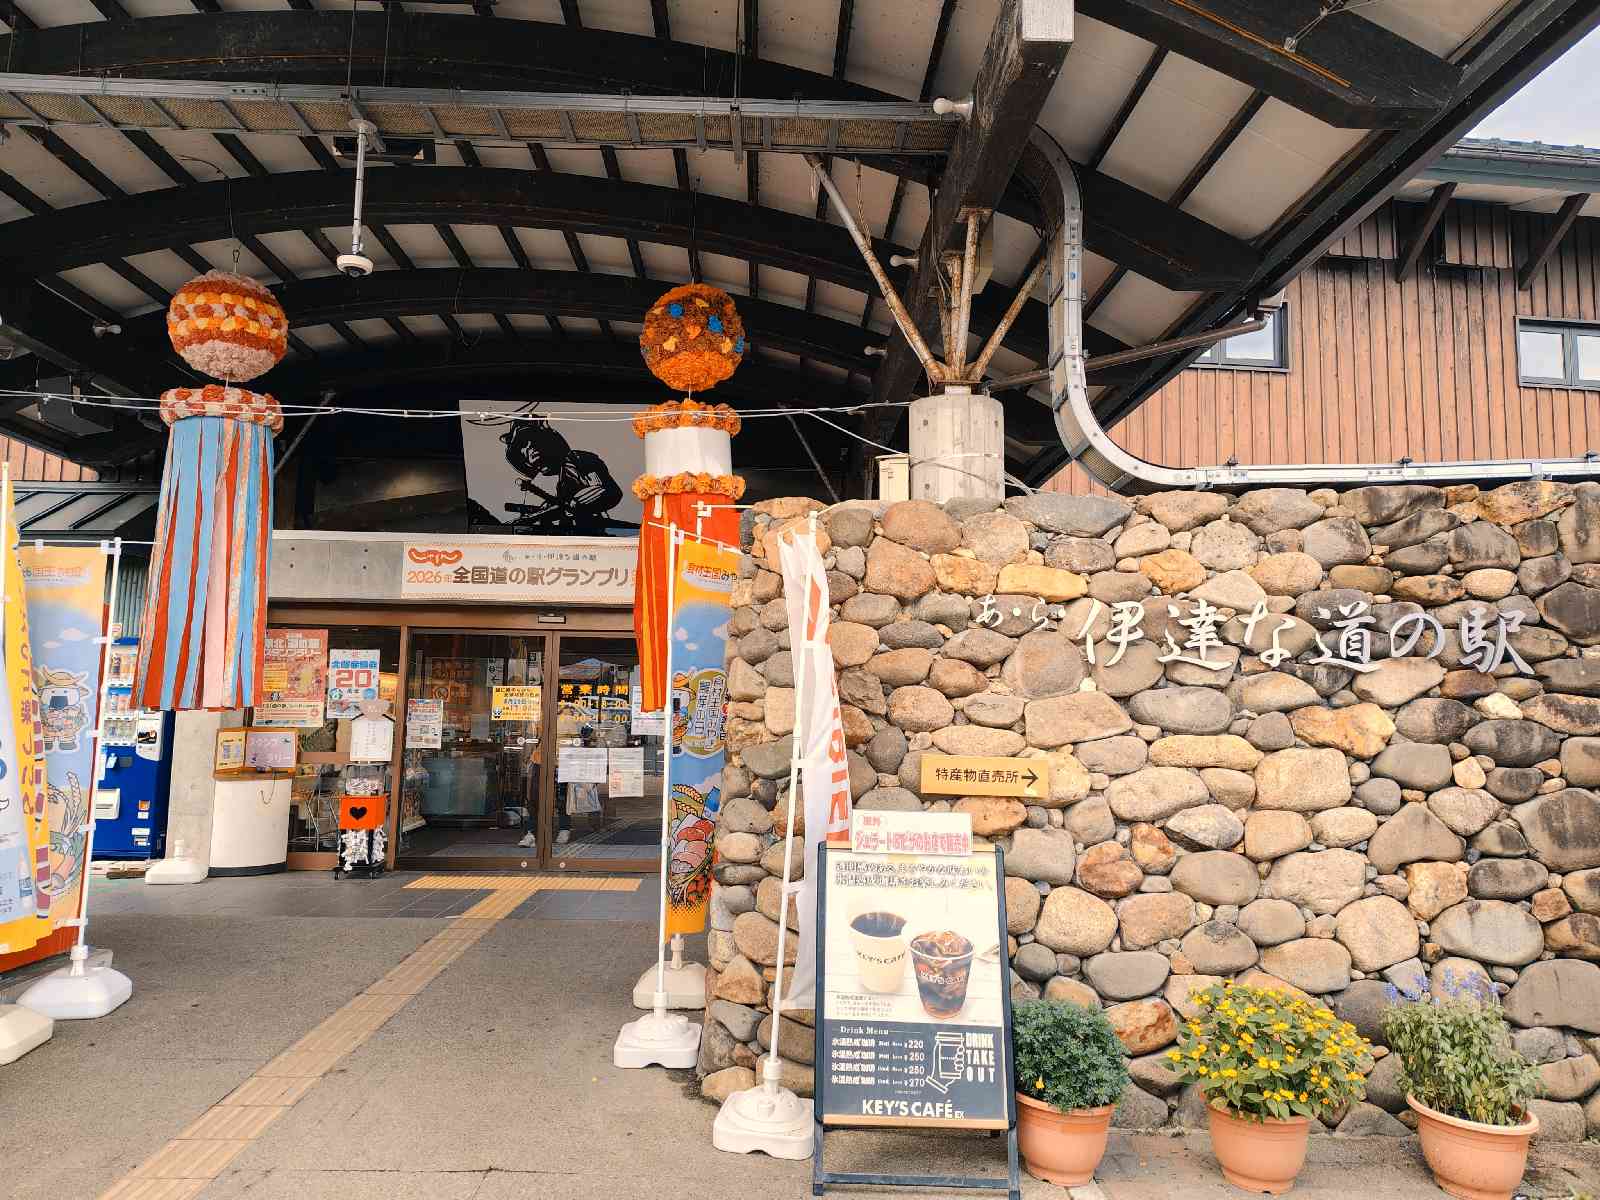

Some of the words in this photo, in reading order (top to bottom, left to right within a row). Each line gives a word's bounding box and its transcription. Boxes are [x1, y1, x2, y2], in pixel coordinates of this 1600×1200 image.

[336, 670, 372, 688] 20
[935, 767, 1019, 784] 特産物直売所
[840, 1026, 864, 1034] Drink
[865, 1027, 889, 1035] Menu
[966, 1050, 995, 1065] TAKE
[967, 1067, 995, 1082] OUT
[862, 1099, 909, 1116] KEY'S
[910, 1099, 953, 1119] CAFÉ
